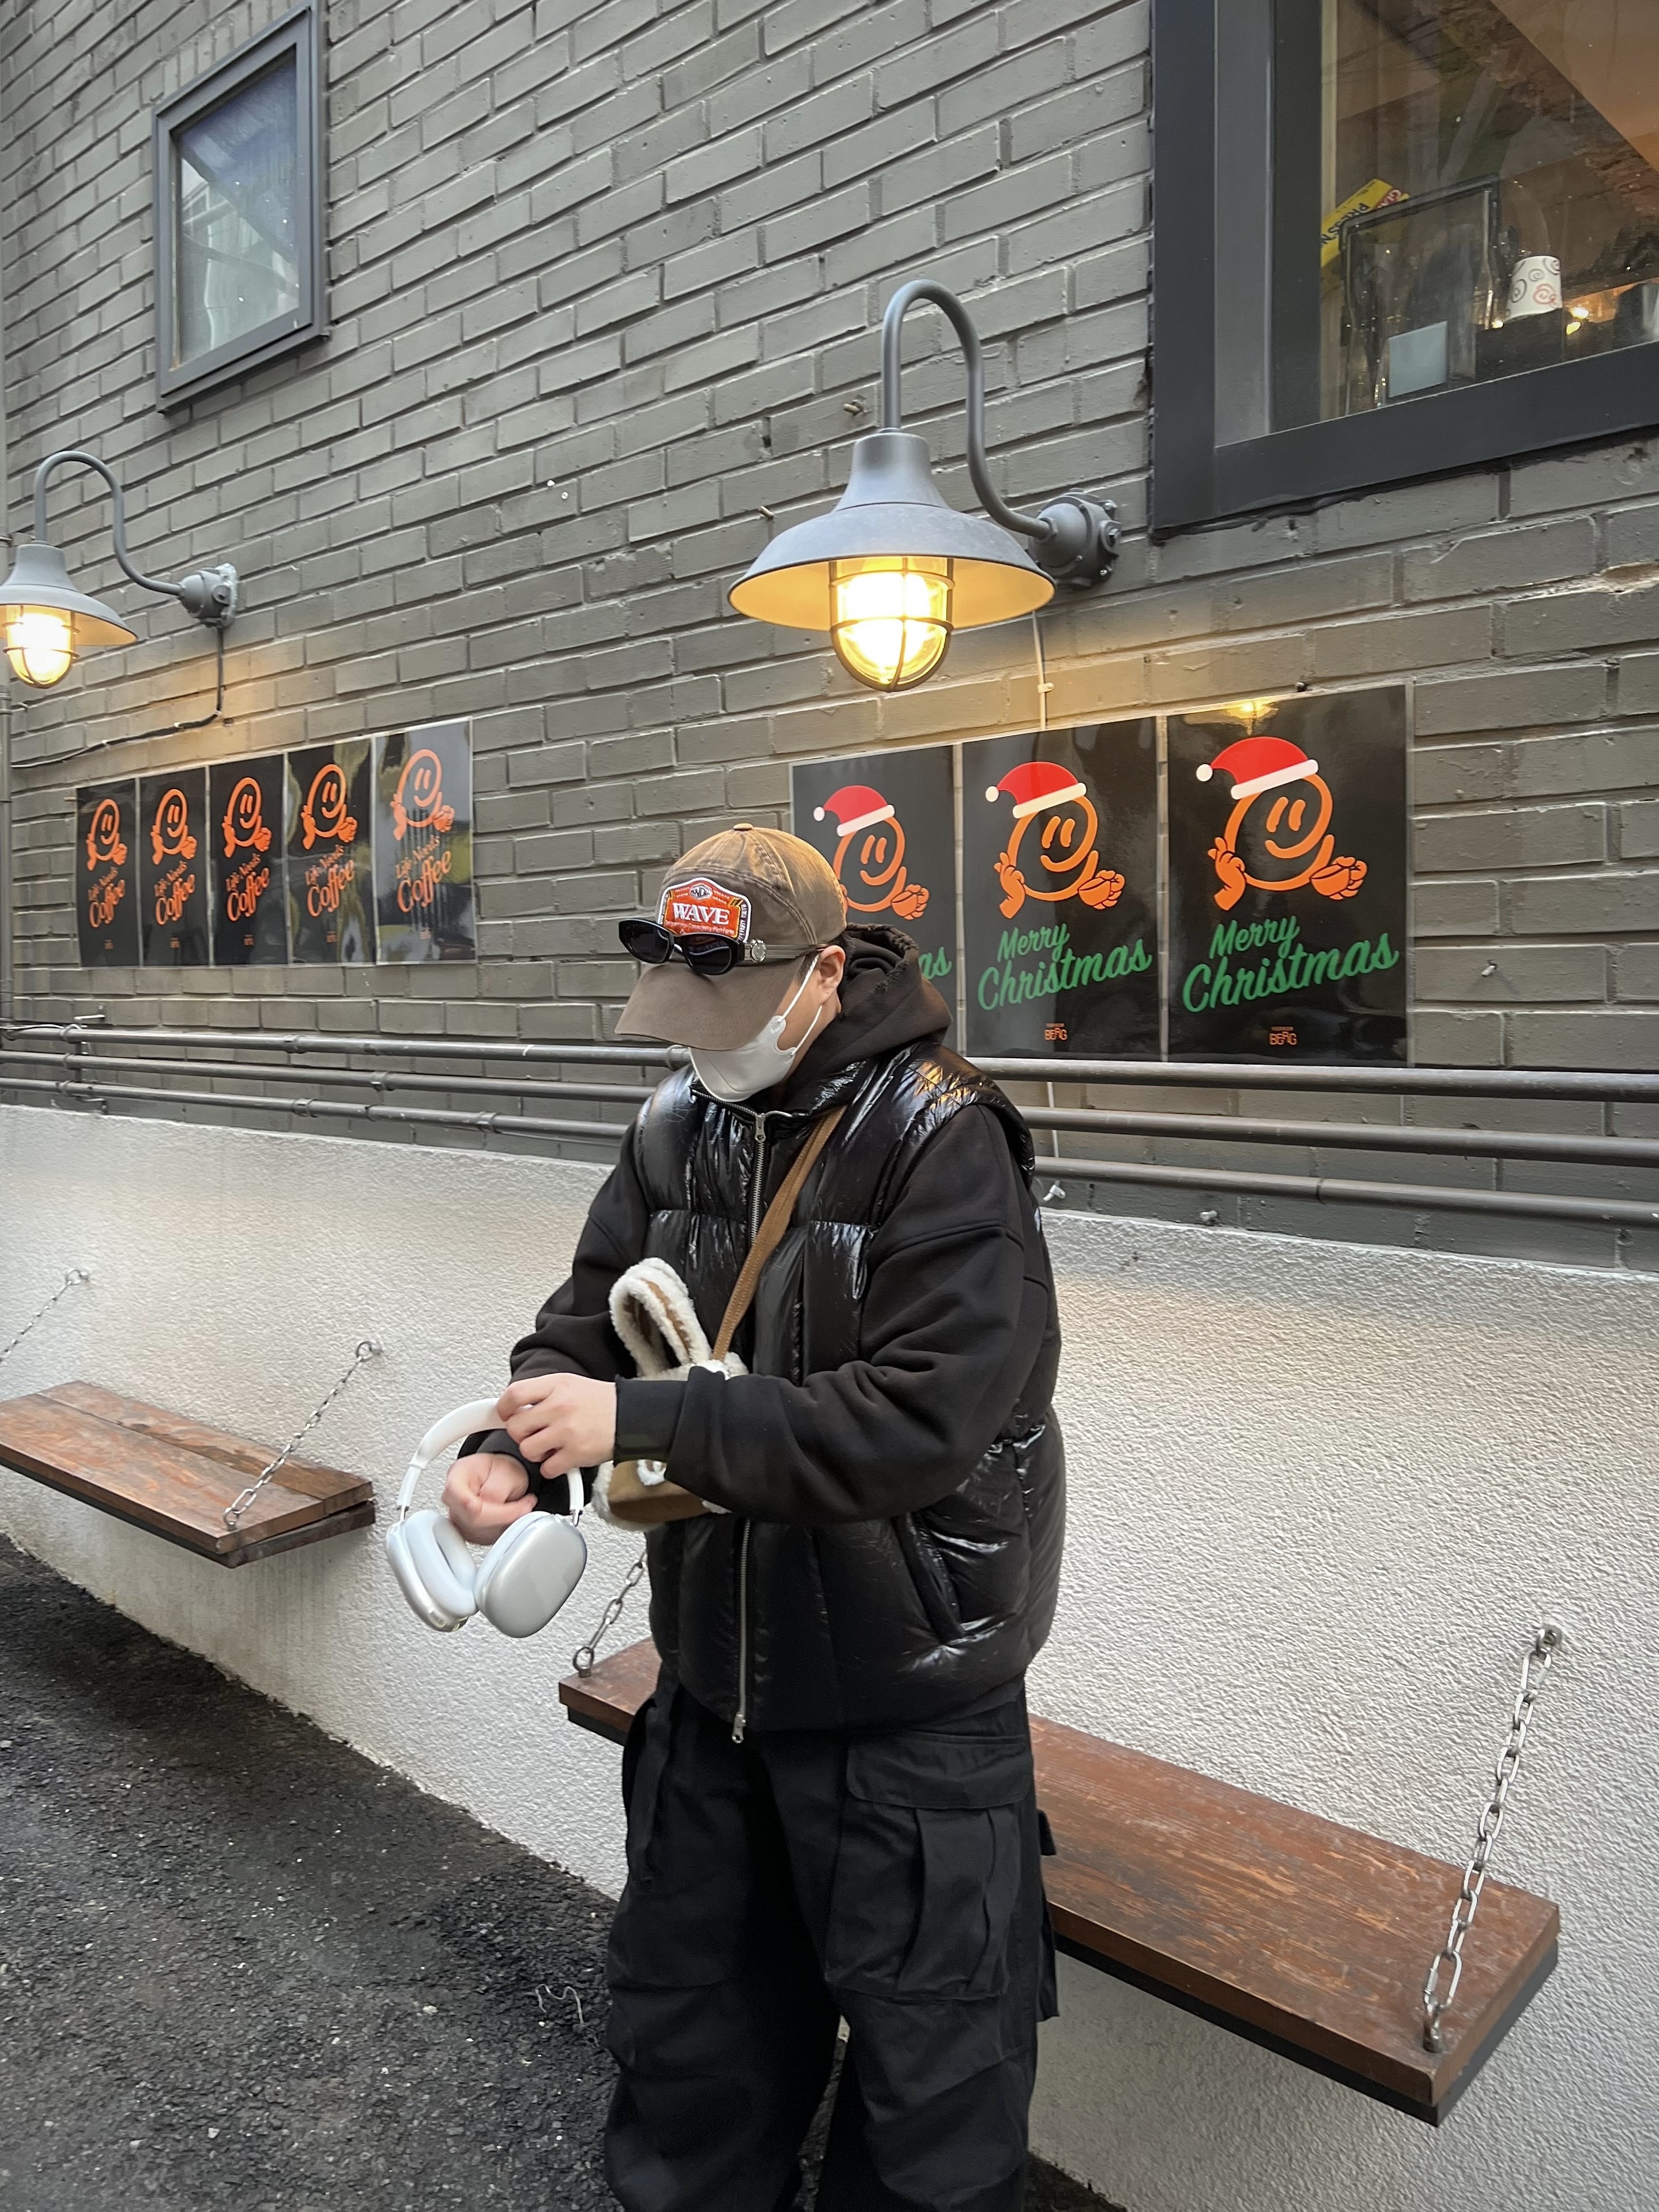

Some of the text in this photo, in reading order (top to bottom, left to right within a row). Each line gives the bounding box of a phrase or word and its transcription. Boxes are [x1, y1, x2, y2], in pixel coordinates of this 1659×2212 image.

[89, 879, 125, 927] Coffee
[156, 874, 195, 924] Coffee
[227, 867, 270, 921] Coffee
[307, 859, 355, 916] Coffee
[397, 851, 452, 912] Coffee
[672, 902, 730, 925] WAVE
[1208, 915, 1300, 959] Merry
[997, 923, 1070, 962] Merry
[978, 939, 1152, 1010] Christmas
[1182, 933, 1400, 1013] Christmas
